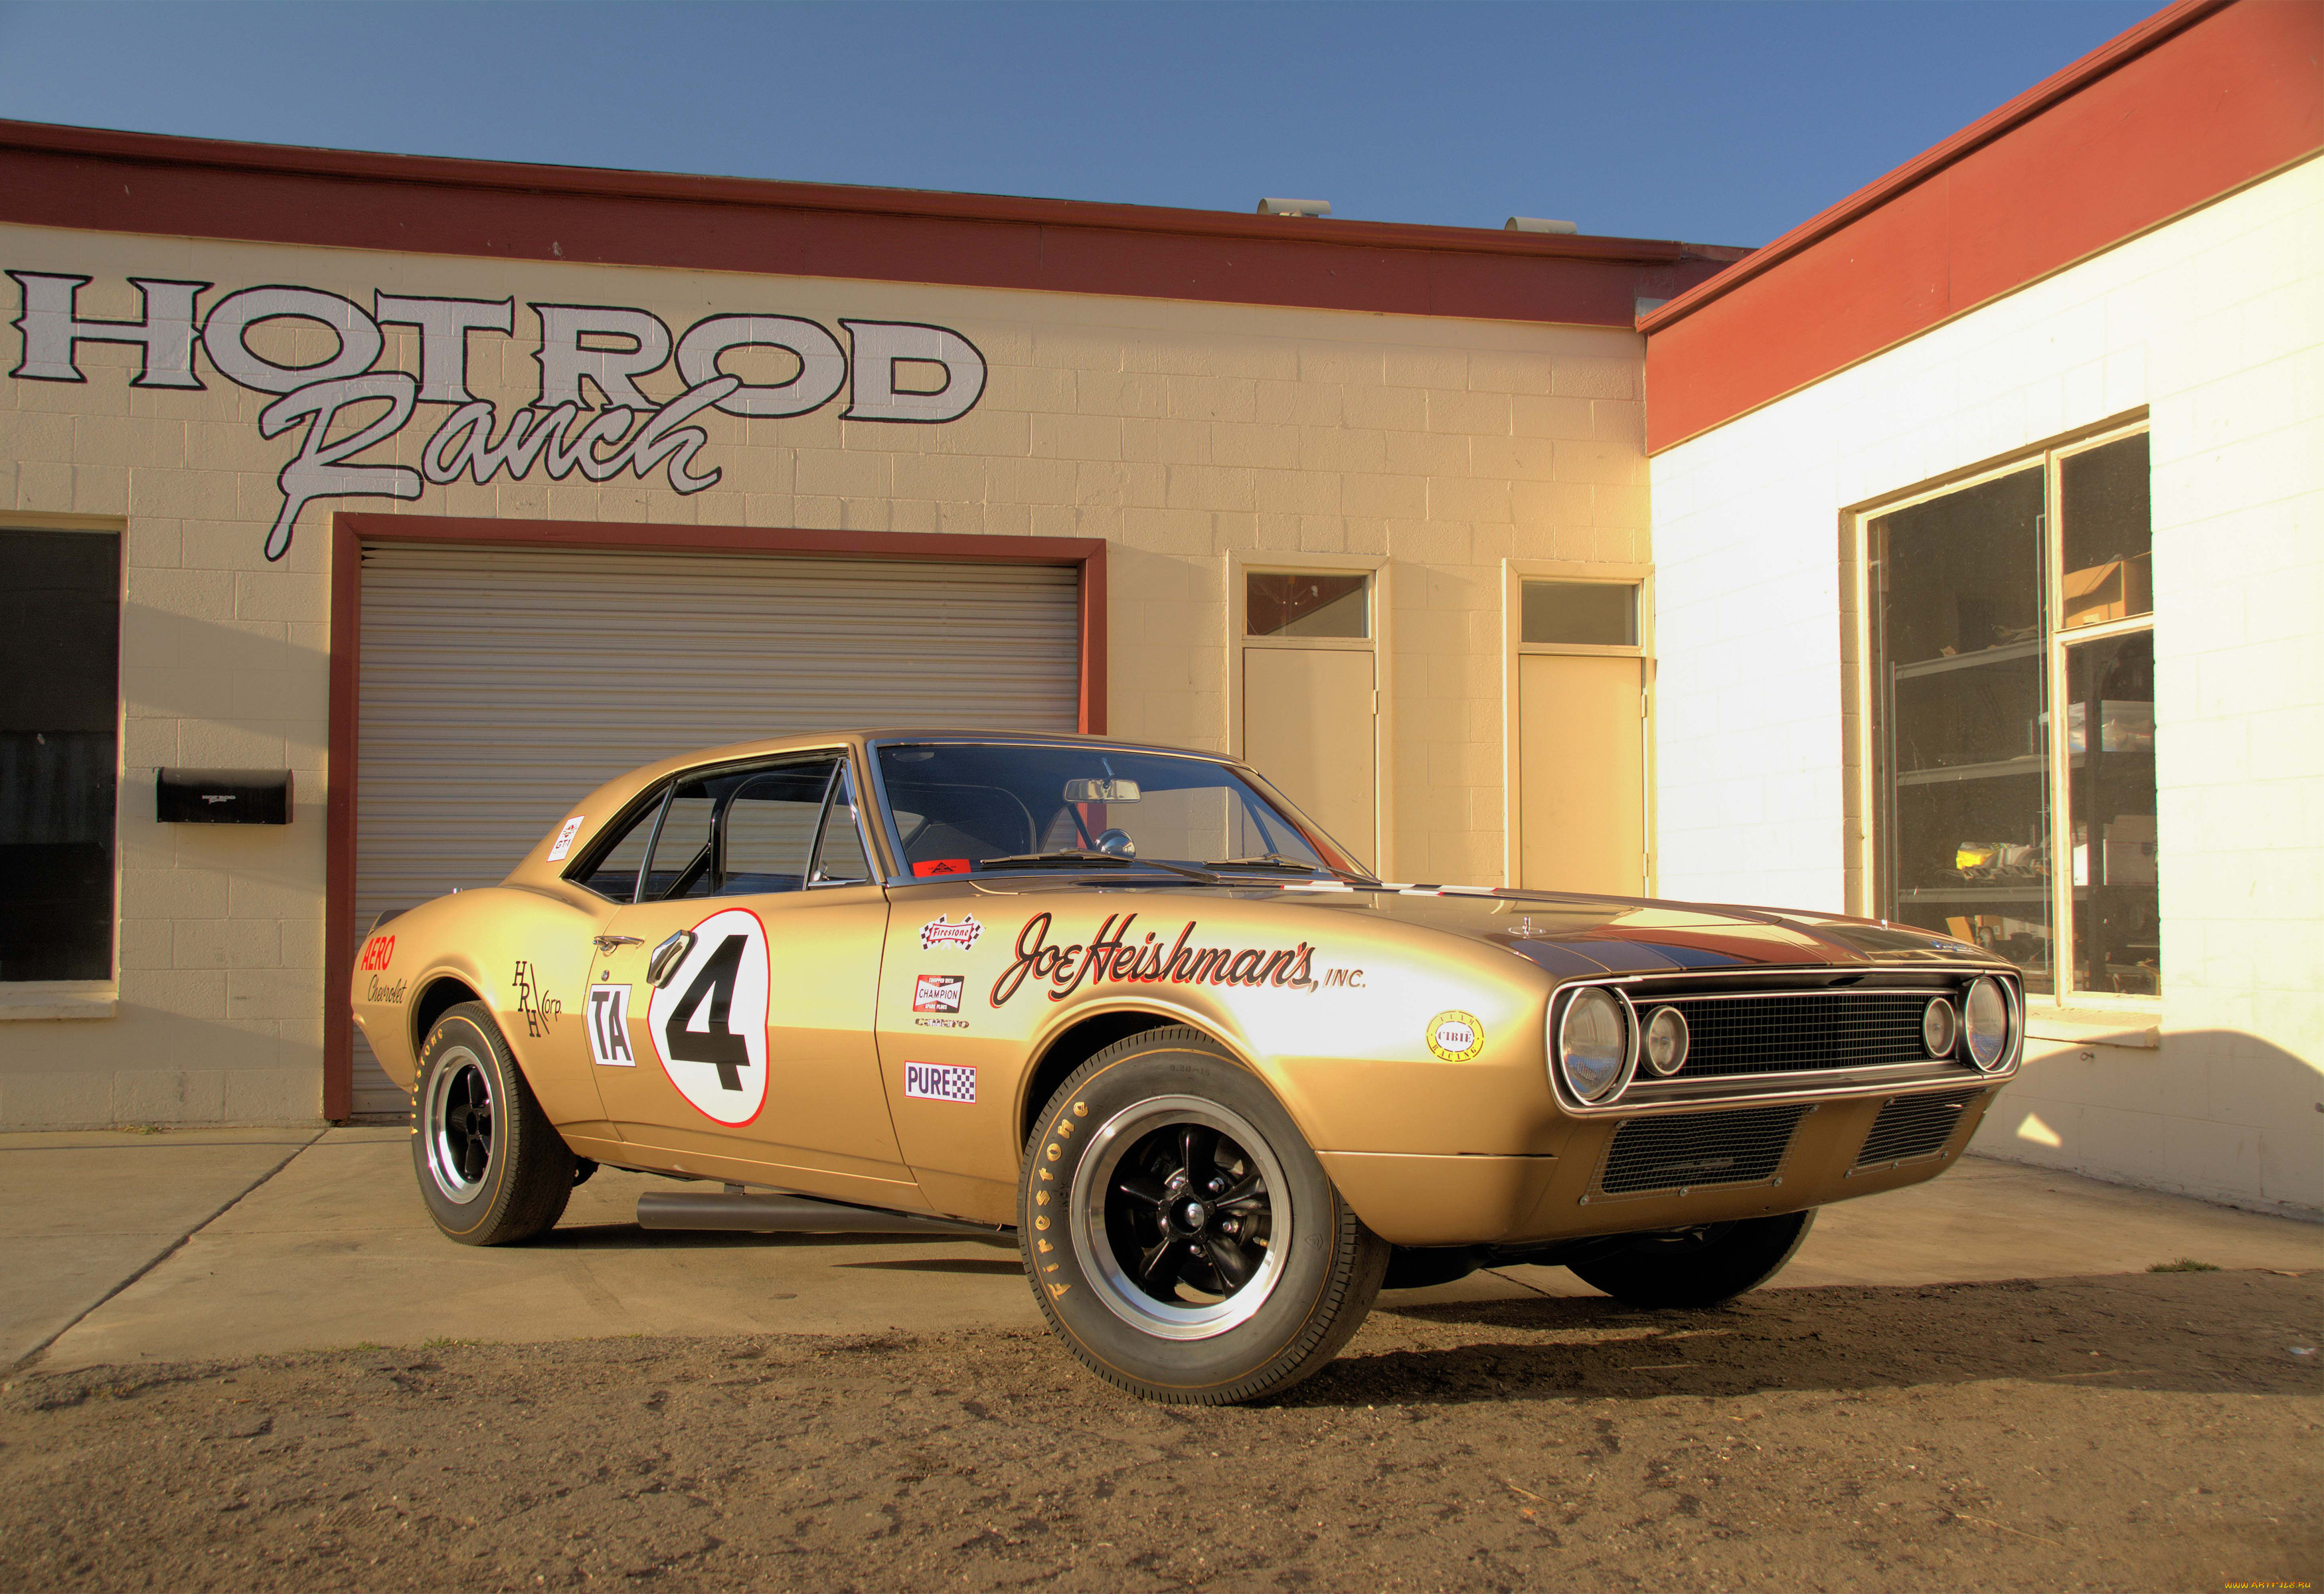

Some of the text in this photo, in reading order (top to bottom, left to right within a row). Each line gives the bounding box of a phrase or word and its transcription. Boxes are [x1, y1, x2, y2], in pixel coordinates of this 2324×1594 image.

[260, 371, 722, 562] Ranch
[932, 926, 969, 938] Firestone
[360, 934, 396, 971] AERO
[367, 973, 408, 1004] Chevrolet
[918, 988, 958, 1000] CHAMPION
[1323, 968, 1368, 989] INC.
[541, 990, 562, 1022] Corp.
[665, 934, 751, 1092] 4
[591, 991, 632, 1061] TA
[1432, 1043, 1477, 1060] RACING
[907, 1065, 950, 1097] PURE
